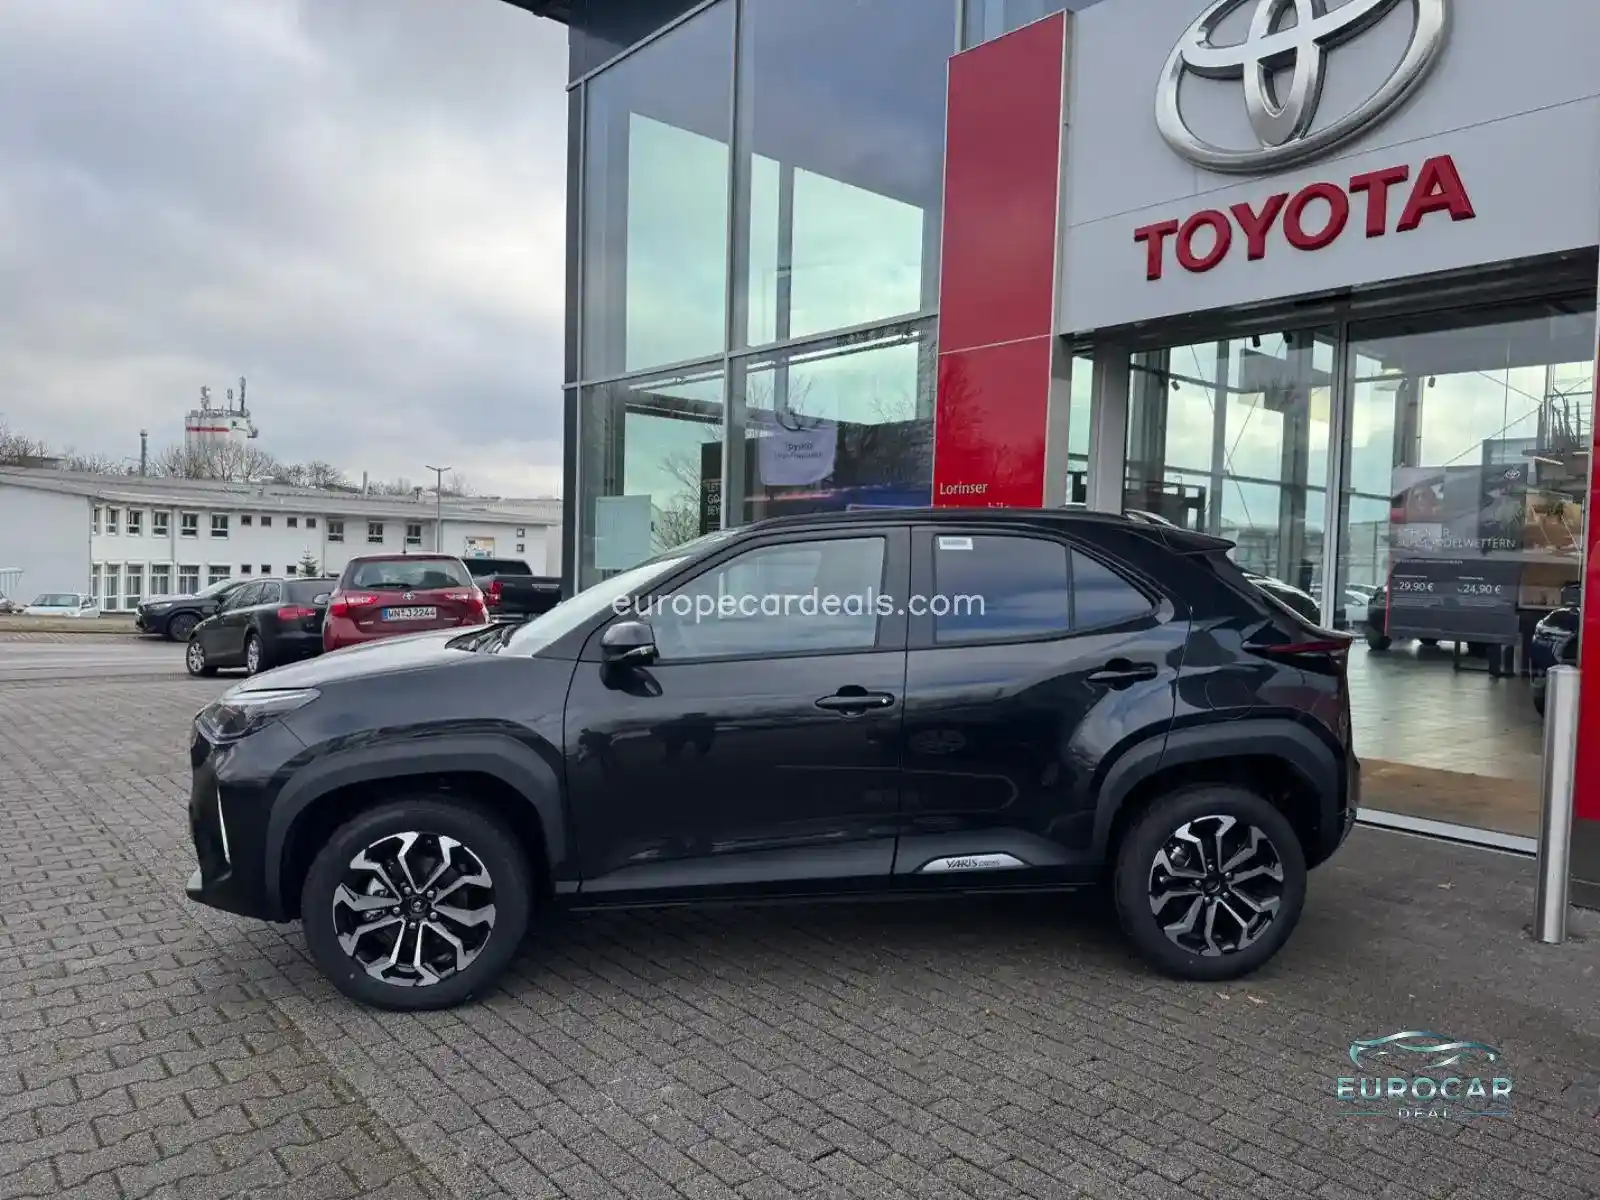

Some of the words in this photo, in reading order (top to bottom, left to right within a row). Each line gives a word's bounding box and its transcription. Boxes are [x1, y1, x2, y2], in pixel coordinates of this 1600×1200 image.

[1134, 154, 1476, 281] TOYOTA
[940, 481, 988, 495] Lorinser
[945, 858, 978, 869] YARIS
